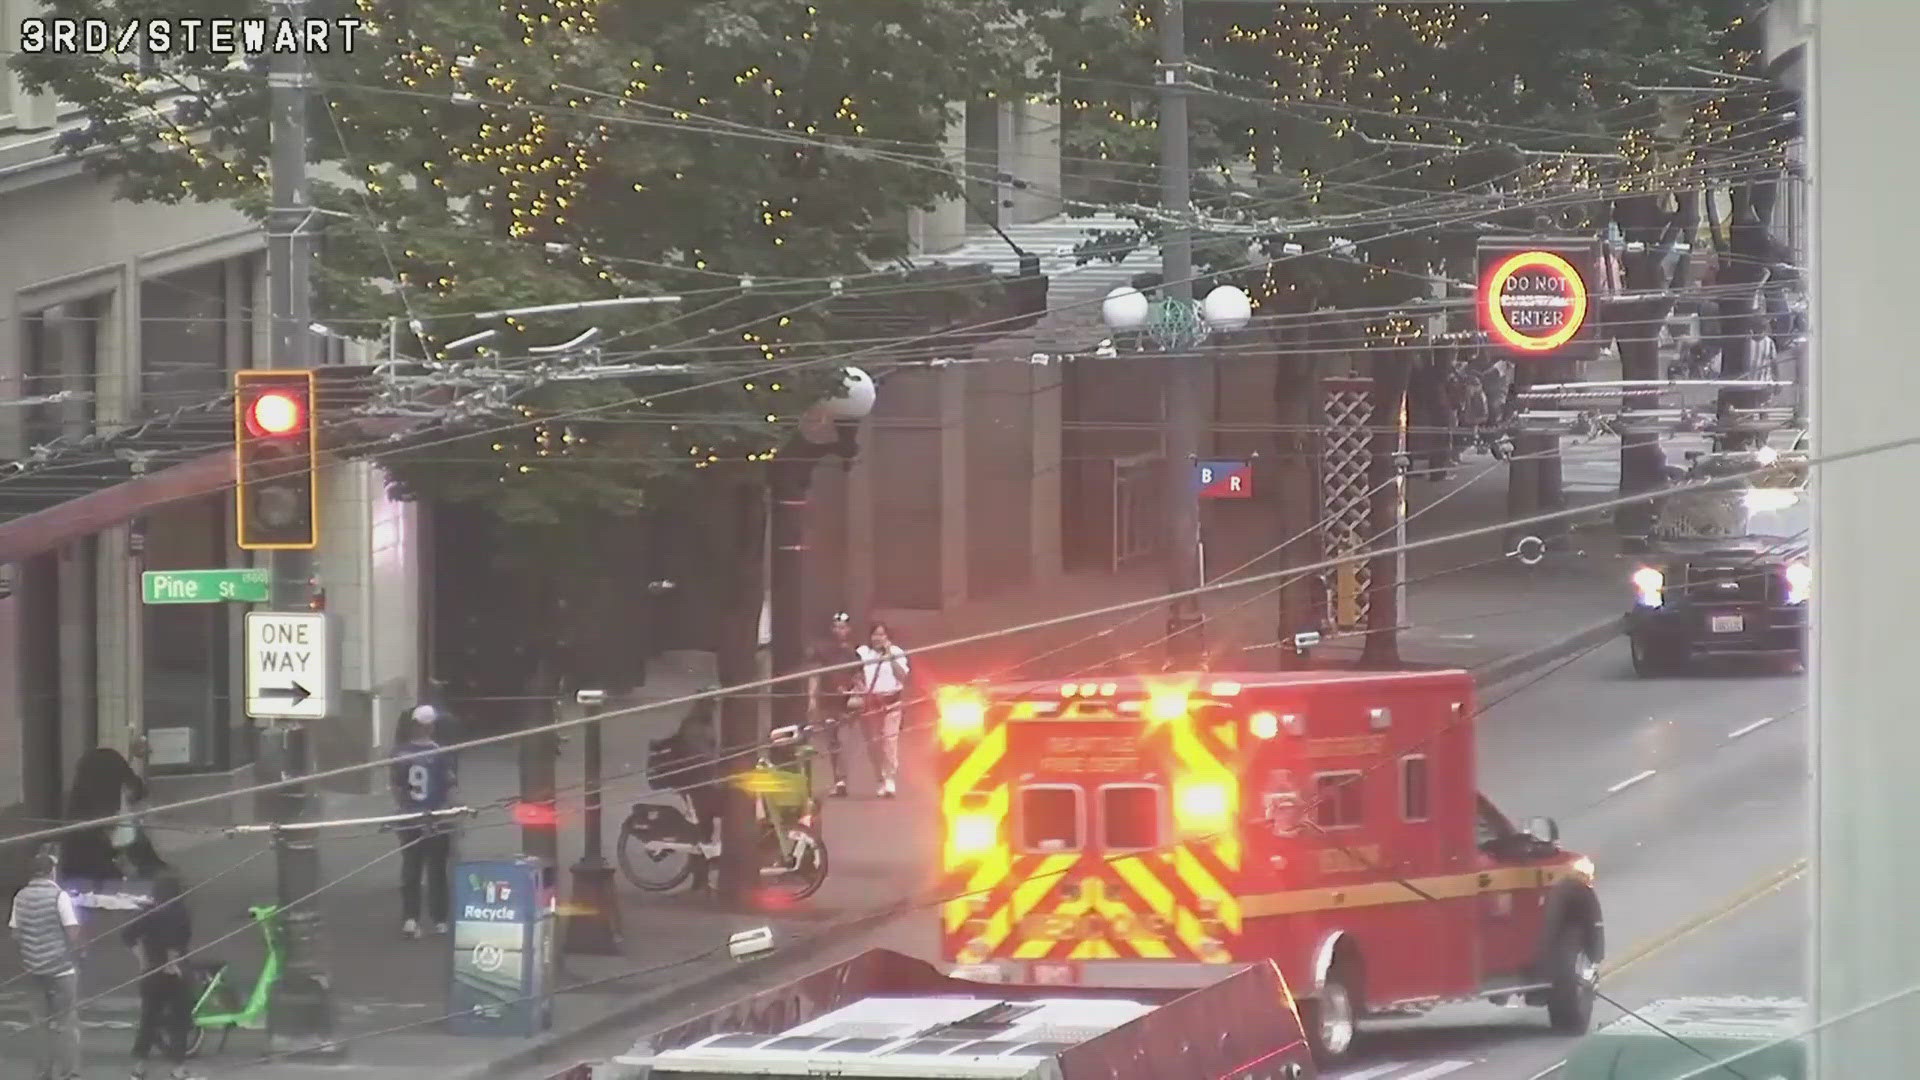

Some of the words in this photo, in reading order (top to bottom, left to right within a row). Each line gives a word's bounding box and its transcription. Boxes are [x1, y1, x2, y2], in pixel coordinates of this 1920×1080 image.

[1506, 275, 1530, 292] DO
[1535, 275, 1567, 292] NOT
[1511, 309, 1564, 326] ENTER
[1202, 467, 1213, 484] B
[1230, 475, 1241, 492] R
[153, 574, 199, 599] Pine
[218, 580, 236, 598] St
[262, 622, 309, 645] ONE
[260, 650, 311, 673] WAY
[408, 764, 429, 802] 9
[464, 904, 516, 922] Recycle
